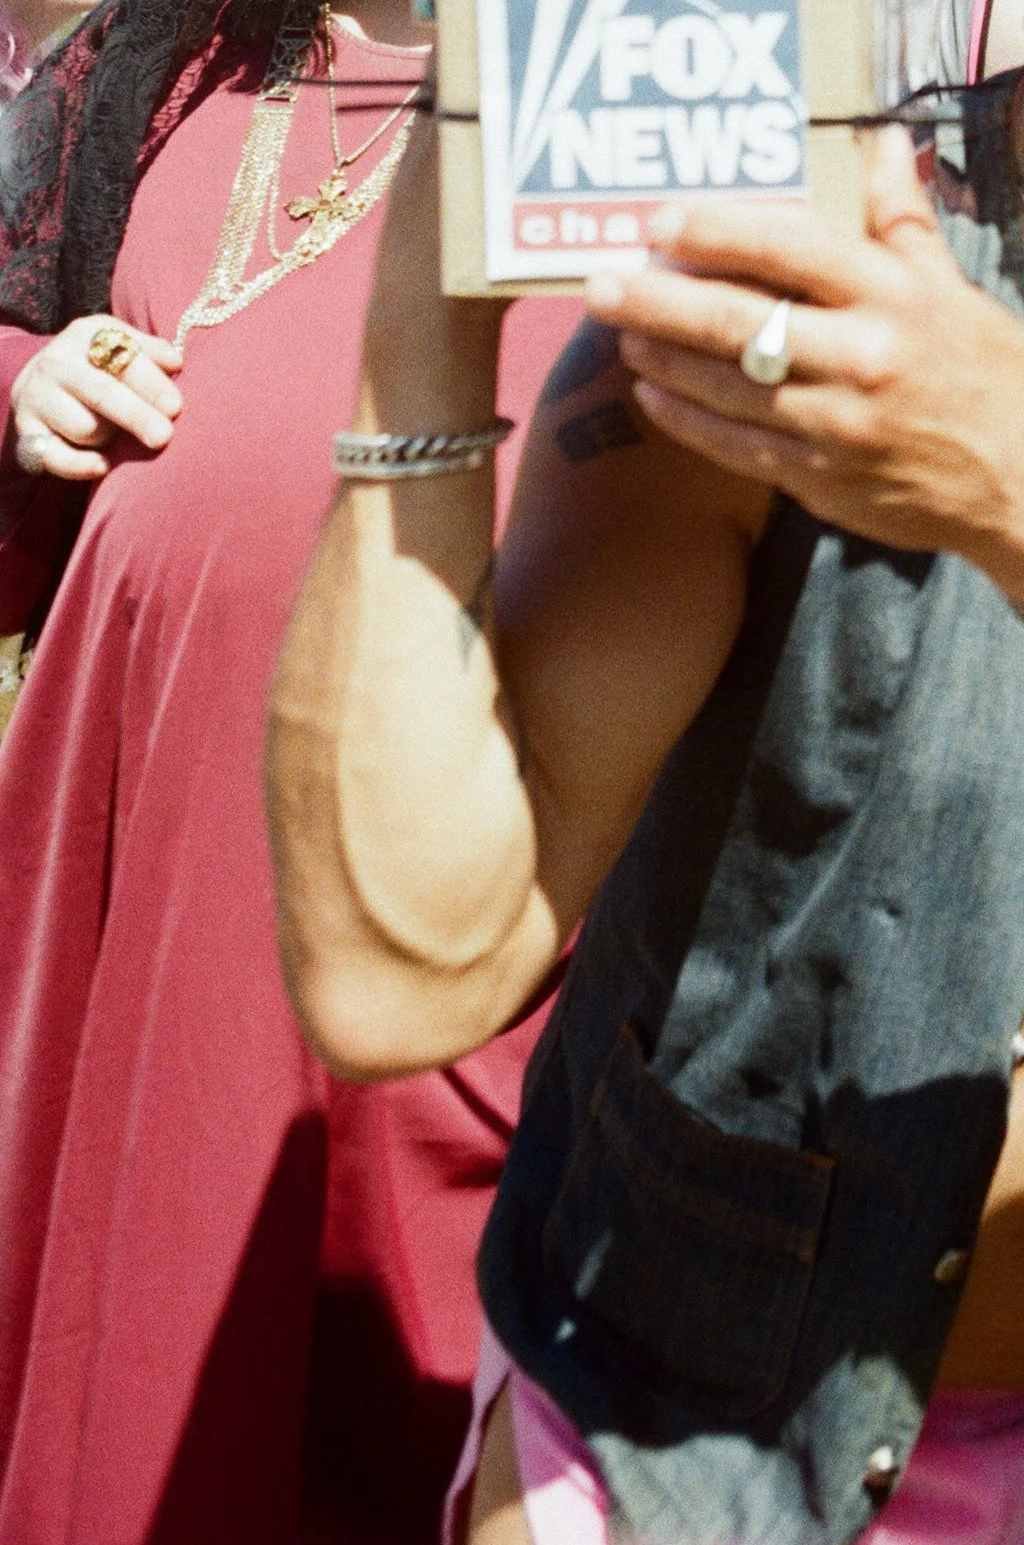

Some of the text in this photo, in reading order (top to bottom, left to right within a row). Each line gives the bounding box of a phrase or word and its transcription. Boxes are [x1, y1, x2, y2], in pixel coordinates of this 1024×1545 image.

[601, 11, 789, 101] FOX
[546, 101, 802, 189] NEWS
[519, 208, 640, 244] cha
